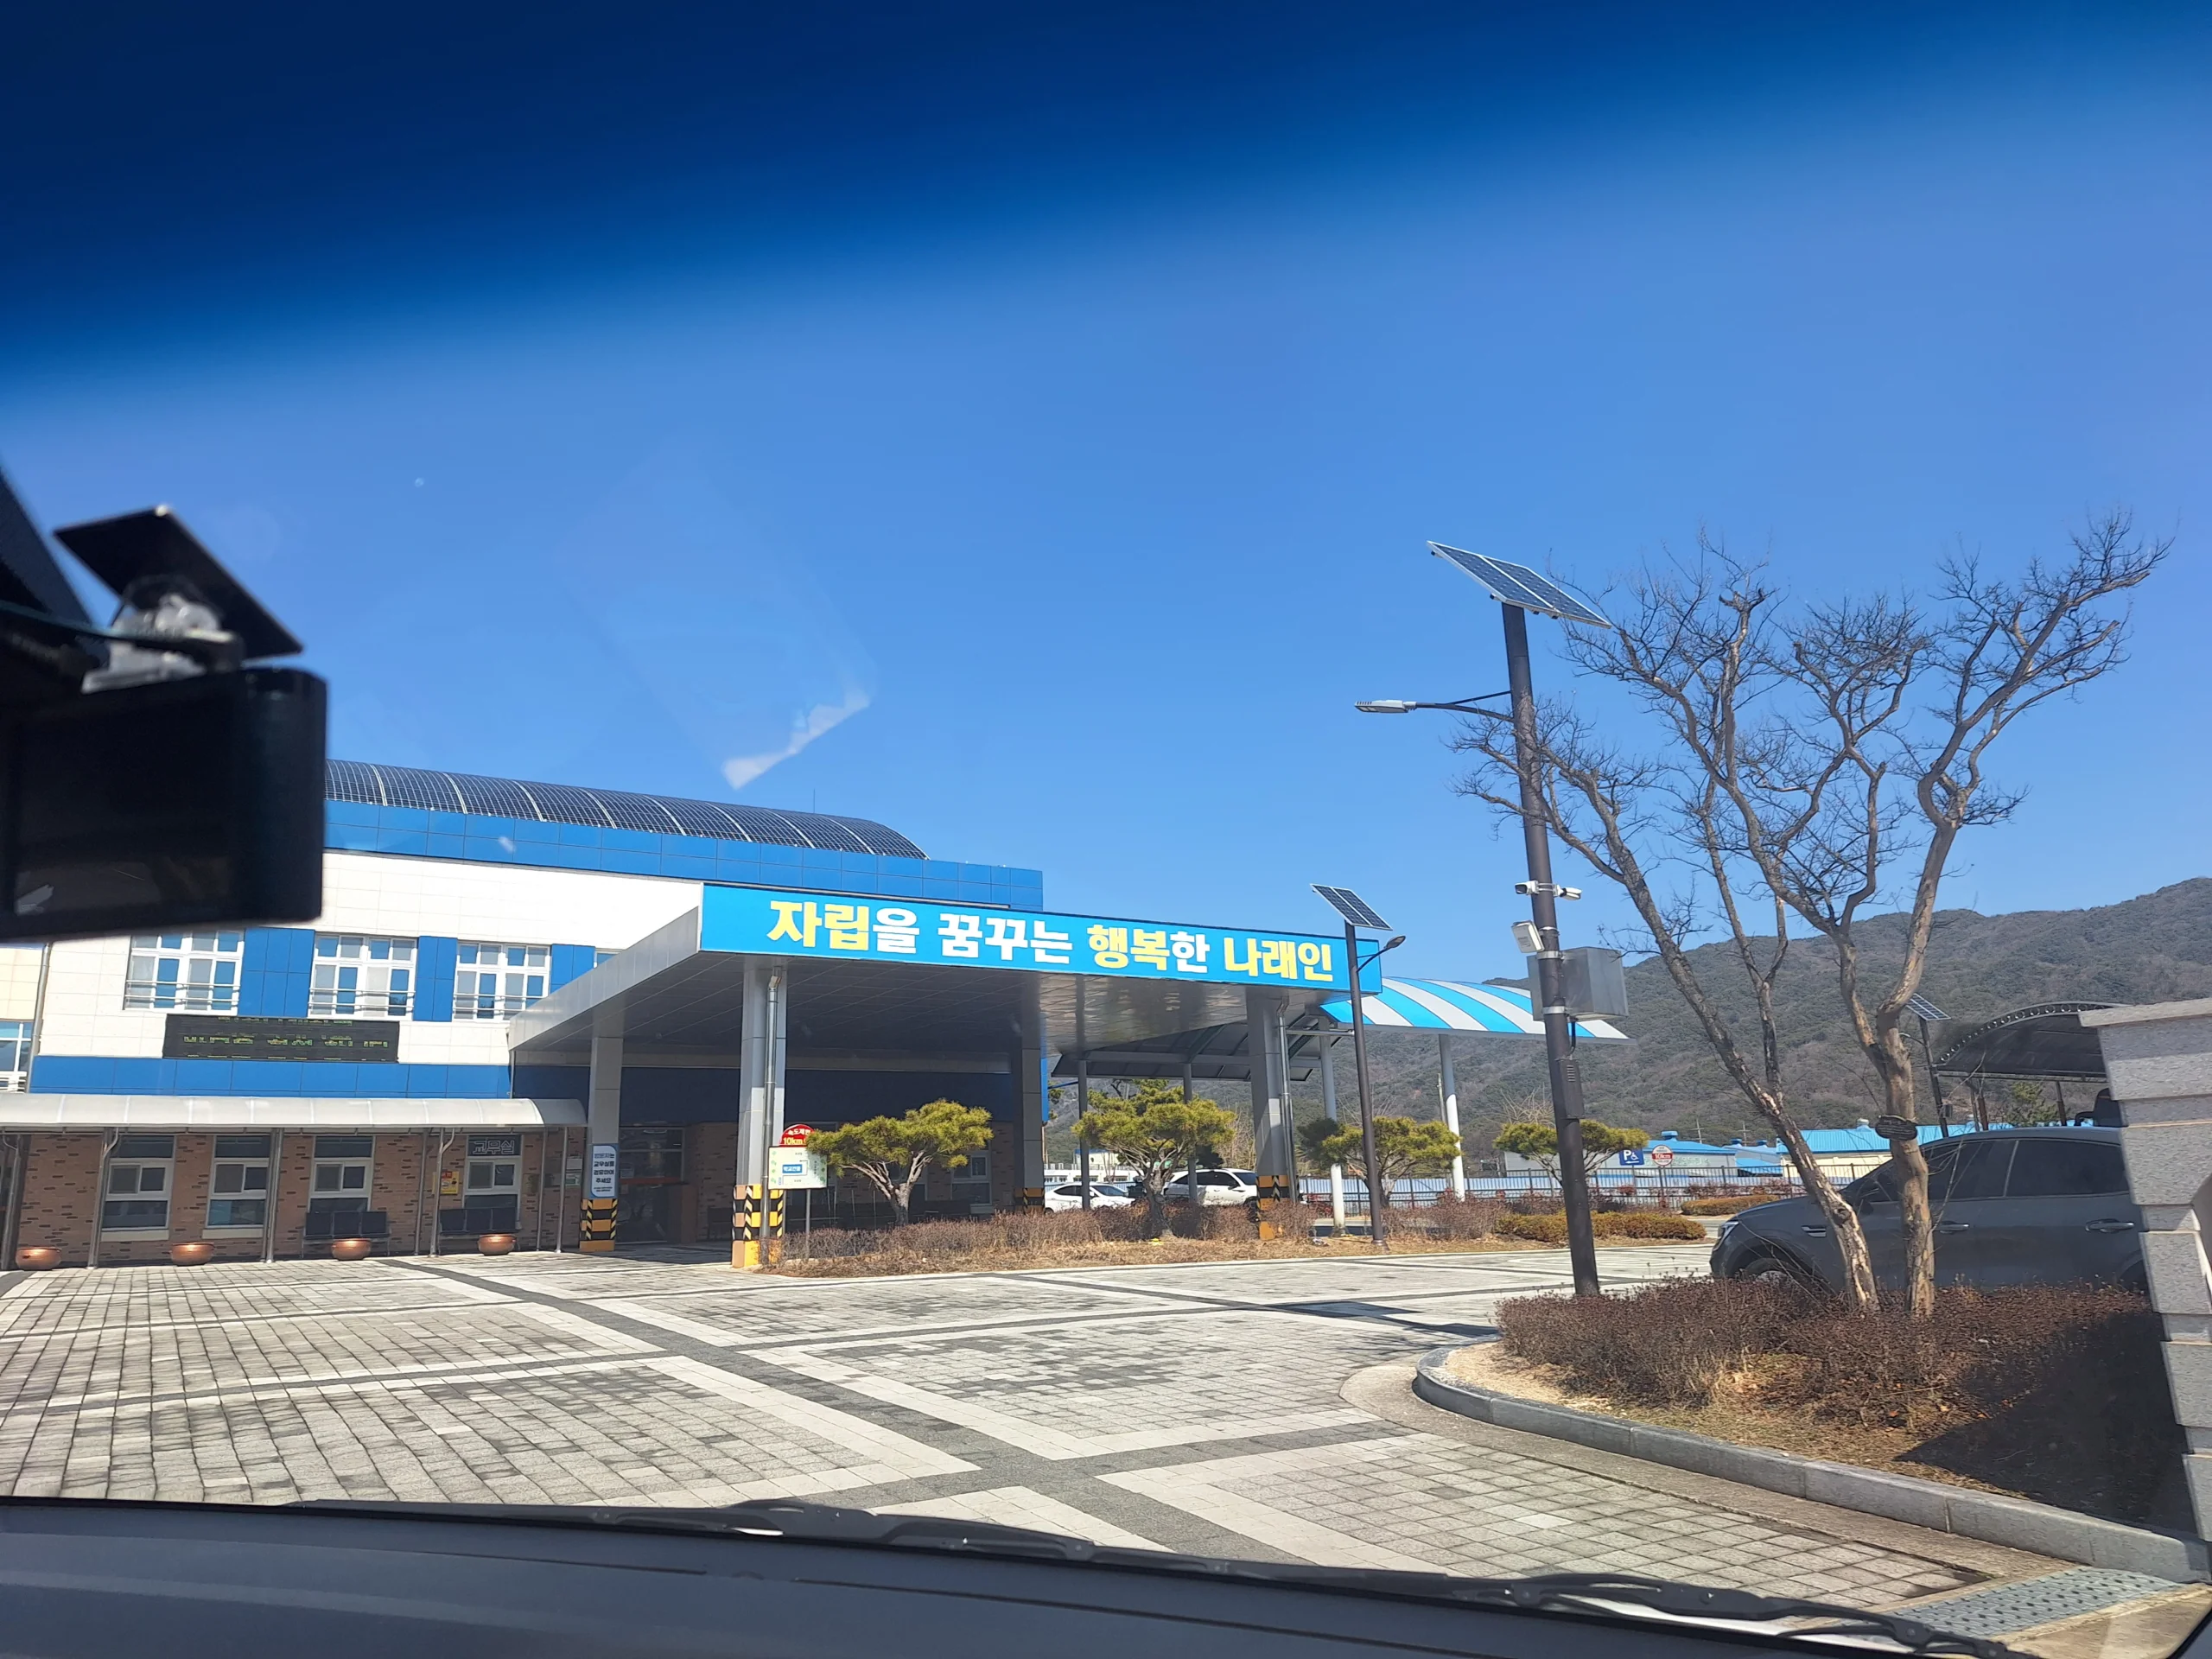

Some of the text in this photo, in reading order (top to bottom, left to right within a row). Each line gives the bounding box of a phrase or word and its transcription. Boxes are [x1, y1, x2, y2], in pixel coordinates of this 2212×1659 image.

[767, 900, 1334, 982] 자립을 꿈꾸는 행복한 나래인
[473, 1140, 515, 1155] 교무실
[1623, 1149, 1631, 1161] P
